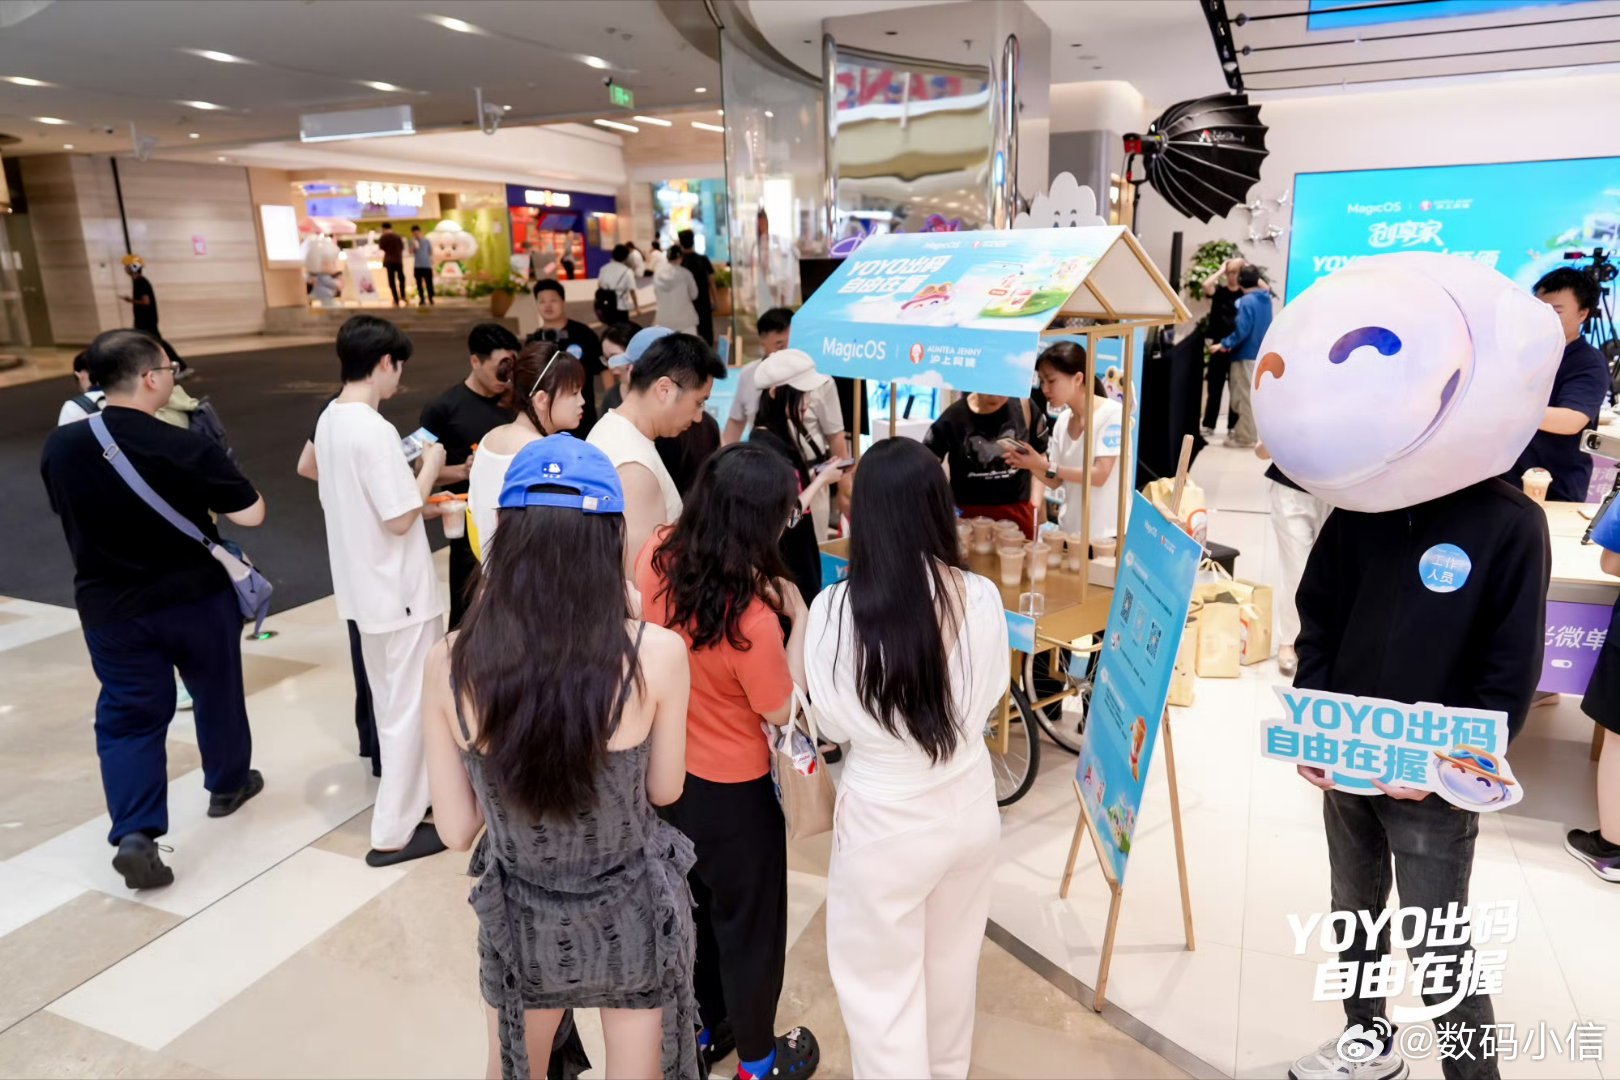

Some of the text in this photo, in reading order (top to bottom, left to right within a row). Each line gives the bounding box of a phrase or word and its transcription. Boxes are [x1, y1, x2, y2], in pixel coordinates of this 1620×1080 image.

[1347, 201, 1402, 216] MagicOS
[1368, 220, 1444, 248] 创享家
[847, 255, 953, 276] YOYO出码
[823, 336, 886, 362] MagicOS
[927, 345, 982, 357] AUNTEA JENNY
[1432, 555, 1457, 570] 工作
[1427, 569, 1454, 585] 人员
[1283, 693, 1497, 753] YOYO出码
[1267, 726, 1428, 788] 自由在握
